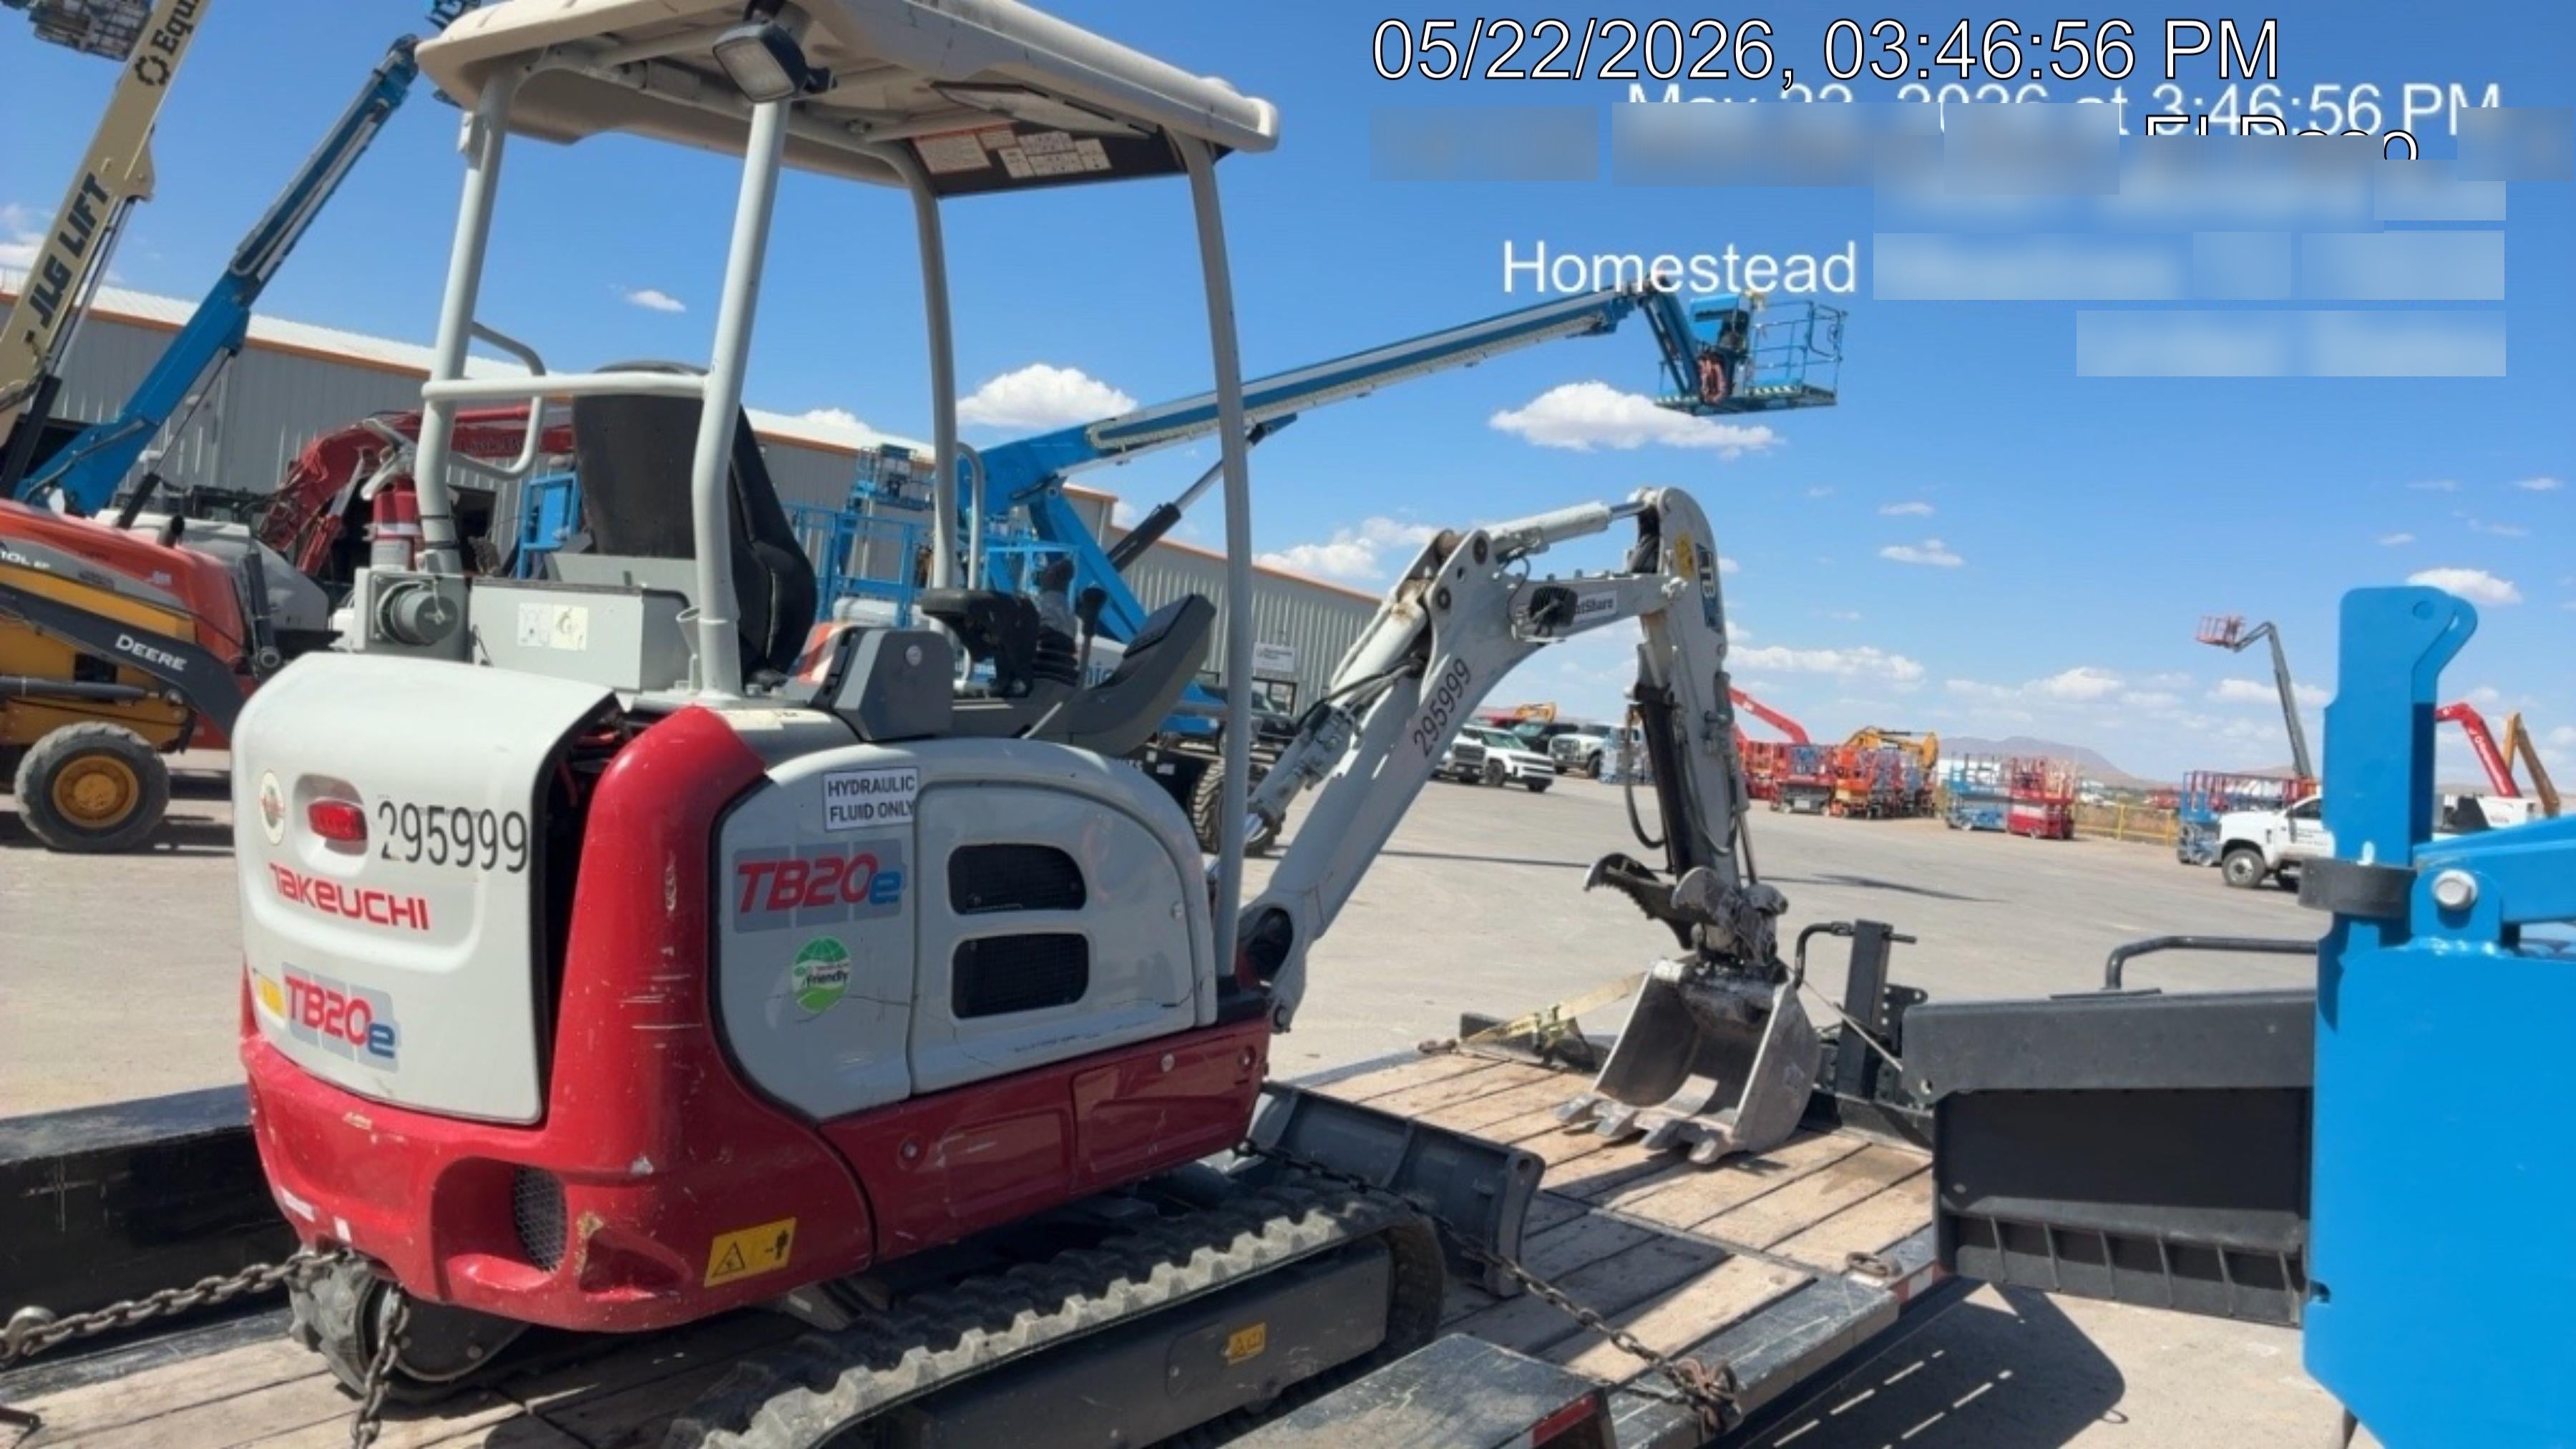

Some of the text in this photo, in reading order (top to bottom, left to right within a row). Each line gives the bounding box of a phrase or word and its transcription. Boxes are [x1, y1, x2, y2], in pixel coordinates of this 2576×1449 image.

[150, 0, 197, 55] Equ
[29, 171, 109, 329] JLG LIFT
[116, 633, 187, 670] DEERE
[1414, 658, 1470, 756] 295999
[828, 775, 915, 796] HYDRAULIC
[831, 799, 914, 822] FLUID ONLY
[379, 800, 527, 874] 295999
[738, 853, 902, 914] TB20e
[284, 975, 396, 1059] TB20e
